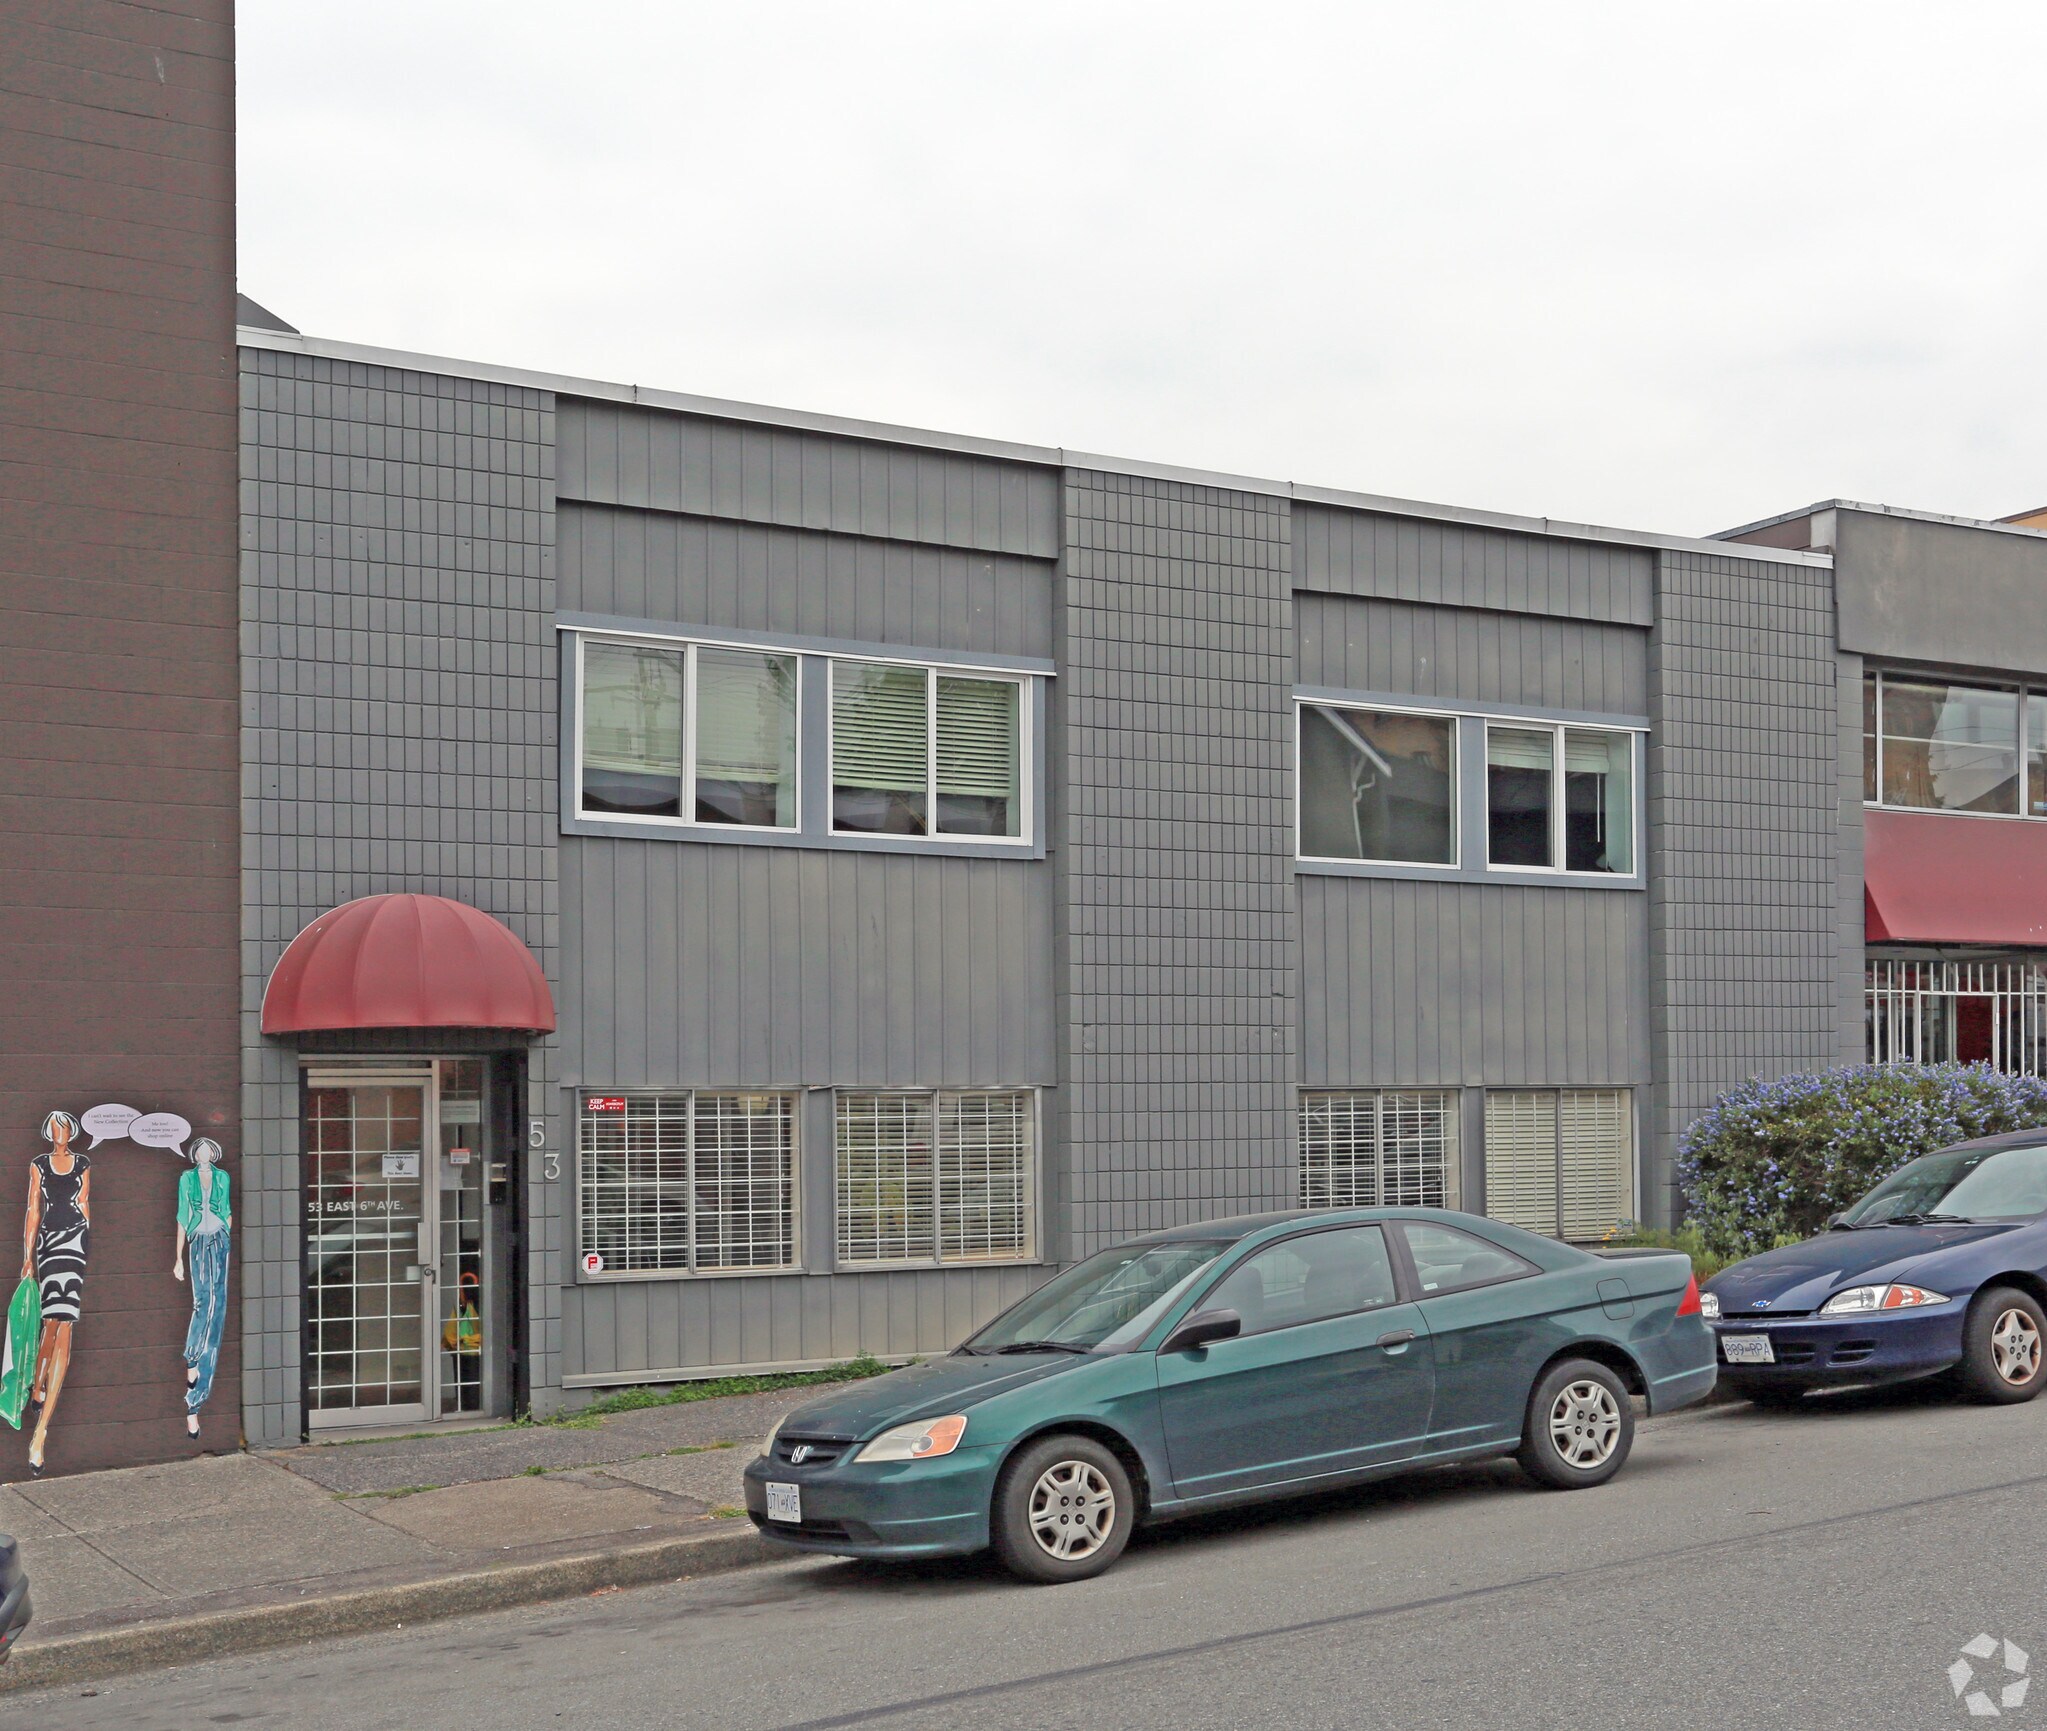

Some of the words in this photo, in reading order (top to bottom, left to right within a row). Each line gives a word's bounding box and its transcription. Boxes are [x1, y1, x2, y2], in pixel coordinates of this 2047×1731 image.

[529, 1121, 561, 1180] 53
[307, 1202, 323, 1212] 53
[326, 1201, 355, 1212] EAST
[360, 1200, 376, 1211] 6TH
[376, 1200, 404, 1211] AVE.
[1724, 1343, 1745, 1356] 889
